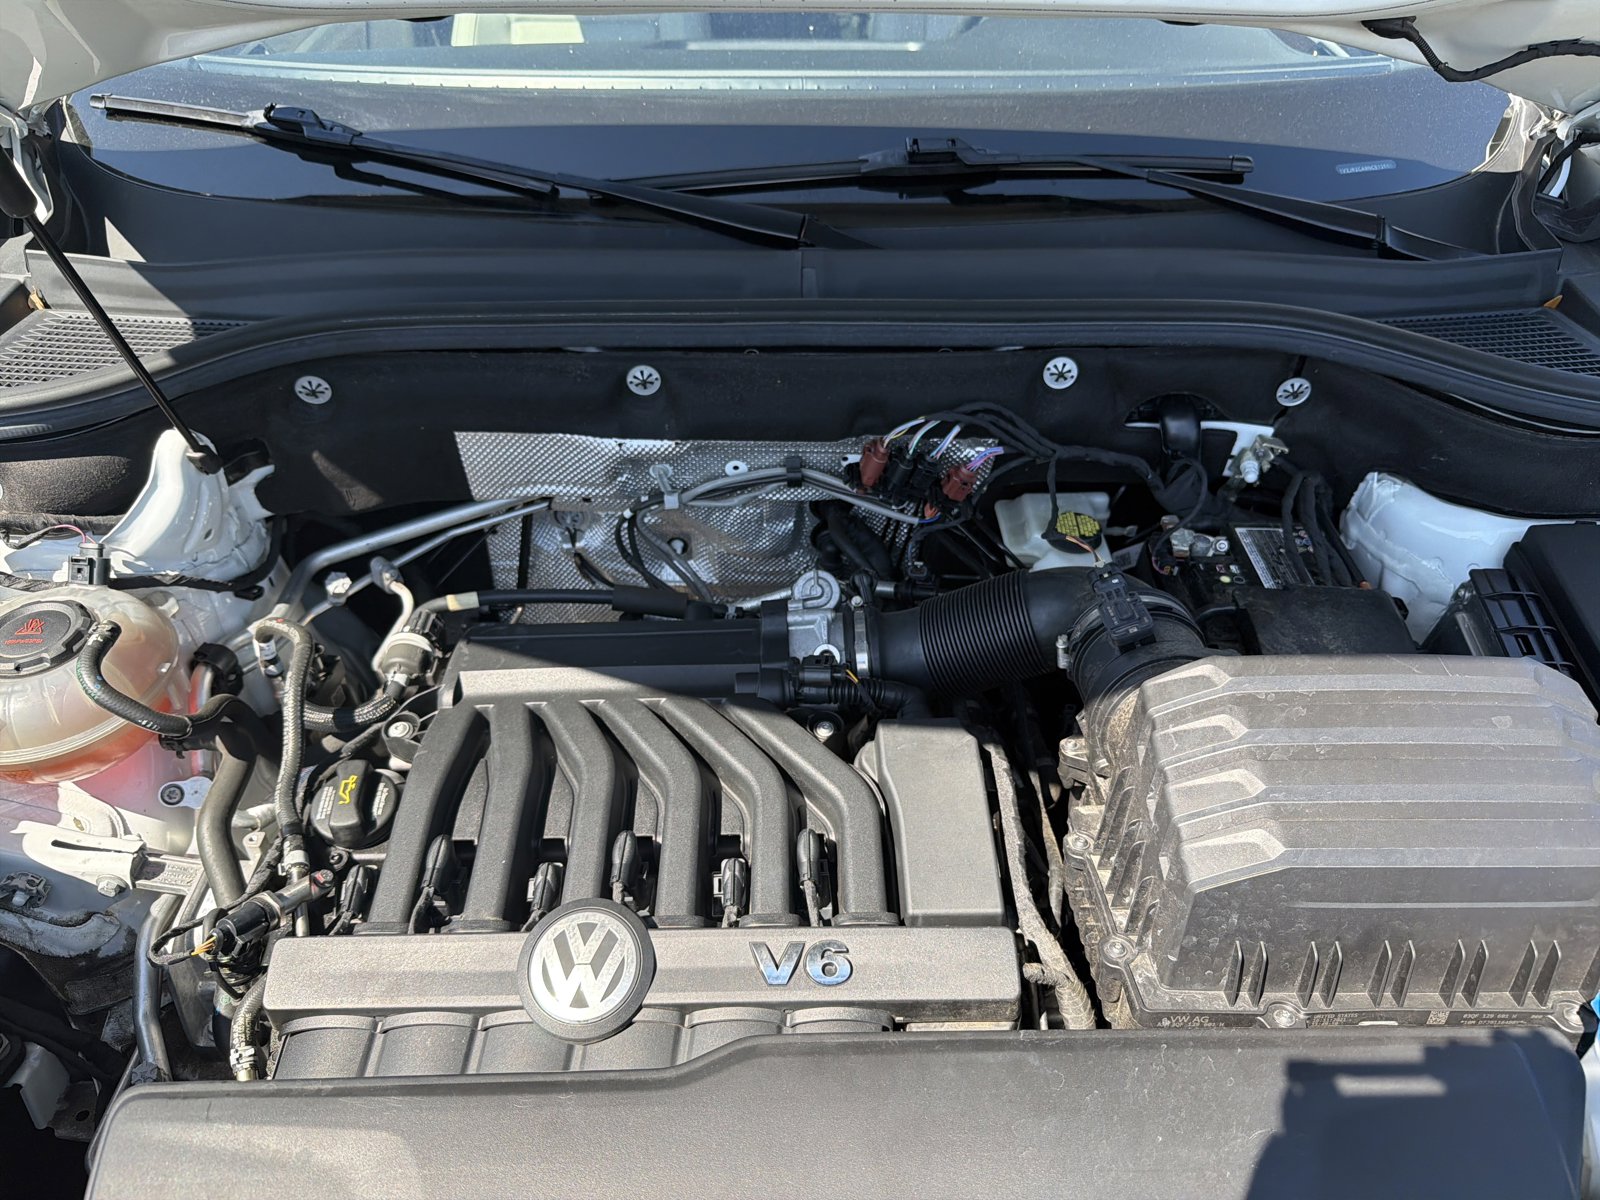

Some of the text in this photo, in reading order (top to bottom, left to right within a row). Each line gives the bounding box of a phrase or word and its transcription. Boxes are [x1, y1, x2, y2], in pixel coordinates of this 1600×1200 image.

[533, 911, 638, 1019] VW
[749, 939, 853, 986] V6
[1170, 1015, 1210, 1023] VW AG
